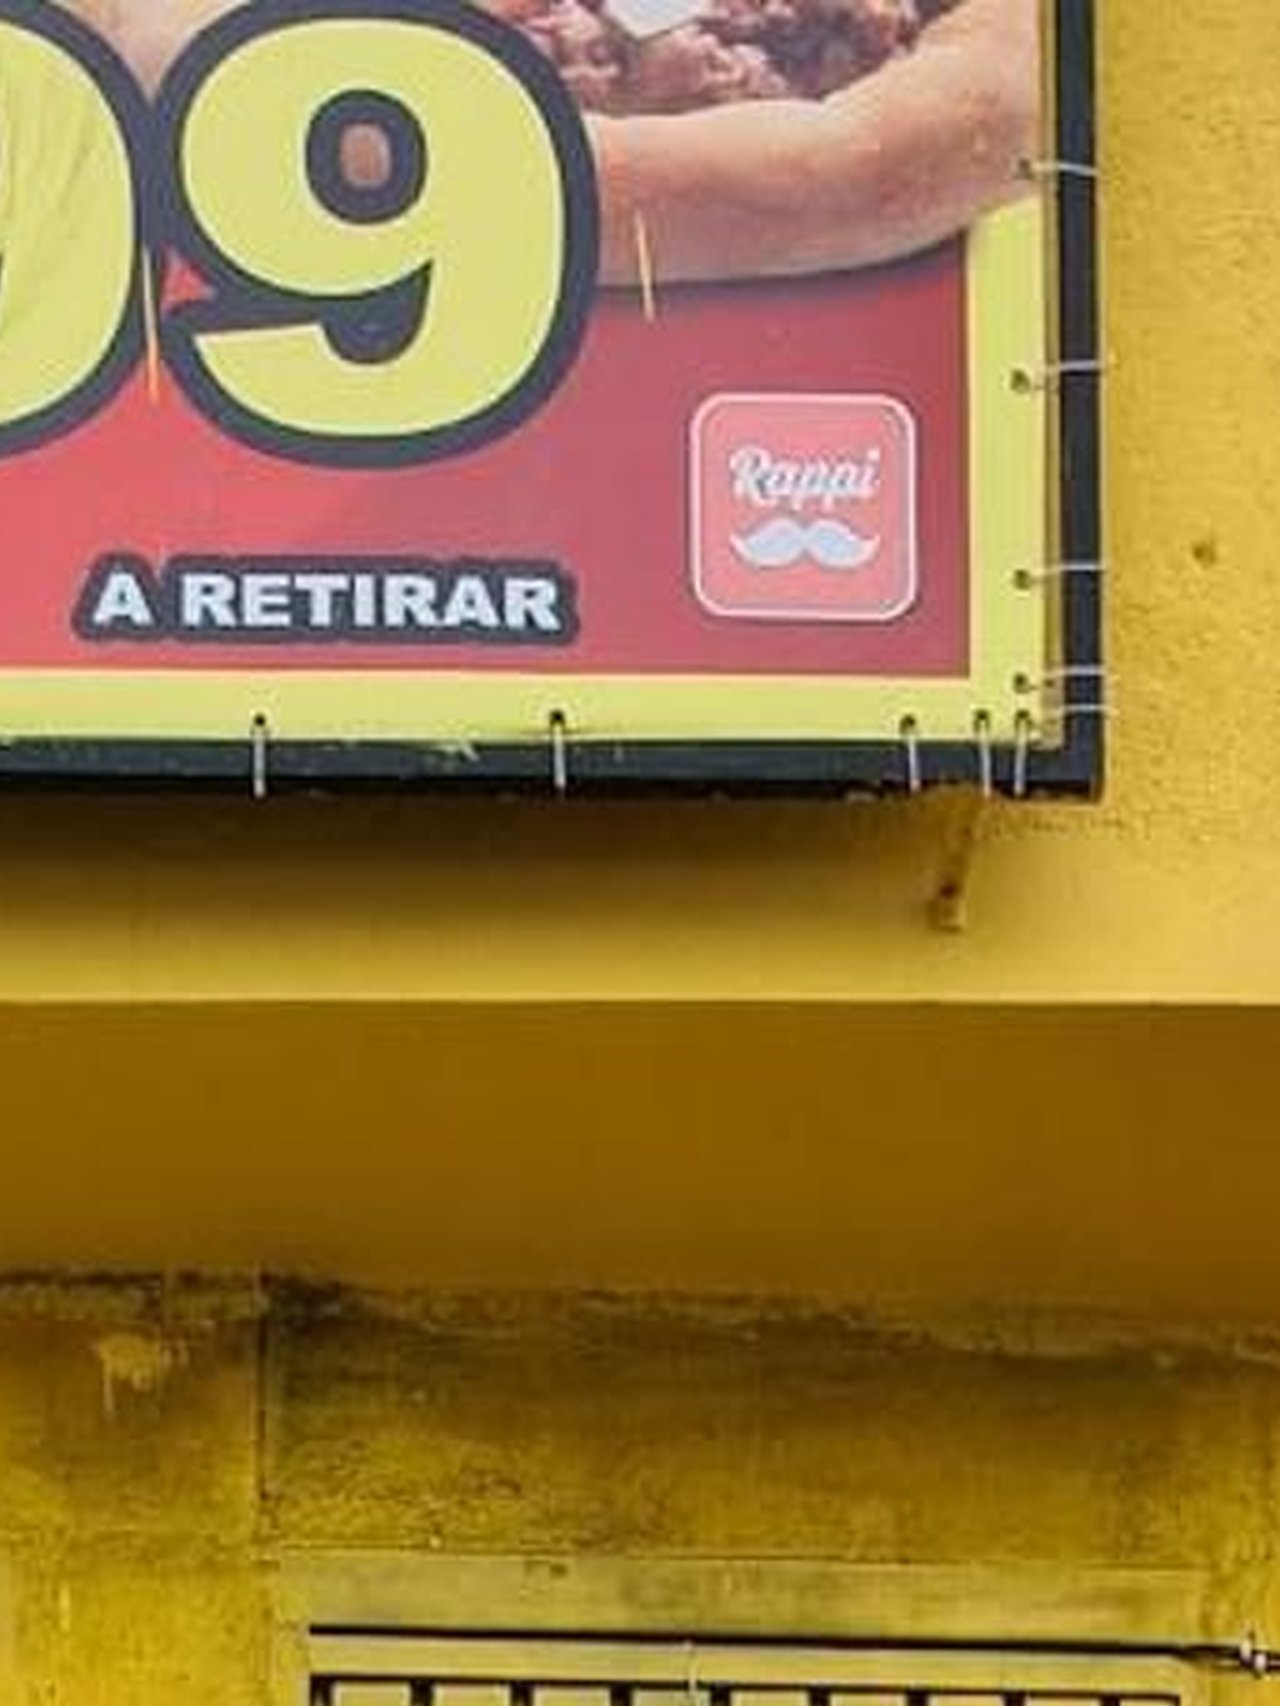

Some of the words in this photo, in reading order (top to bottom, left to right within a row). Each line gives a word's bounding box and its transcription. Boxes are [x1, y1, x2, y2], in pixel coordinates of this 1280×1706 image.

[729, 446, 881, 512] Rappi
[92, 568, 154, 628] A
[180, 570, 563, 633] RETIRAR
